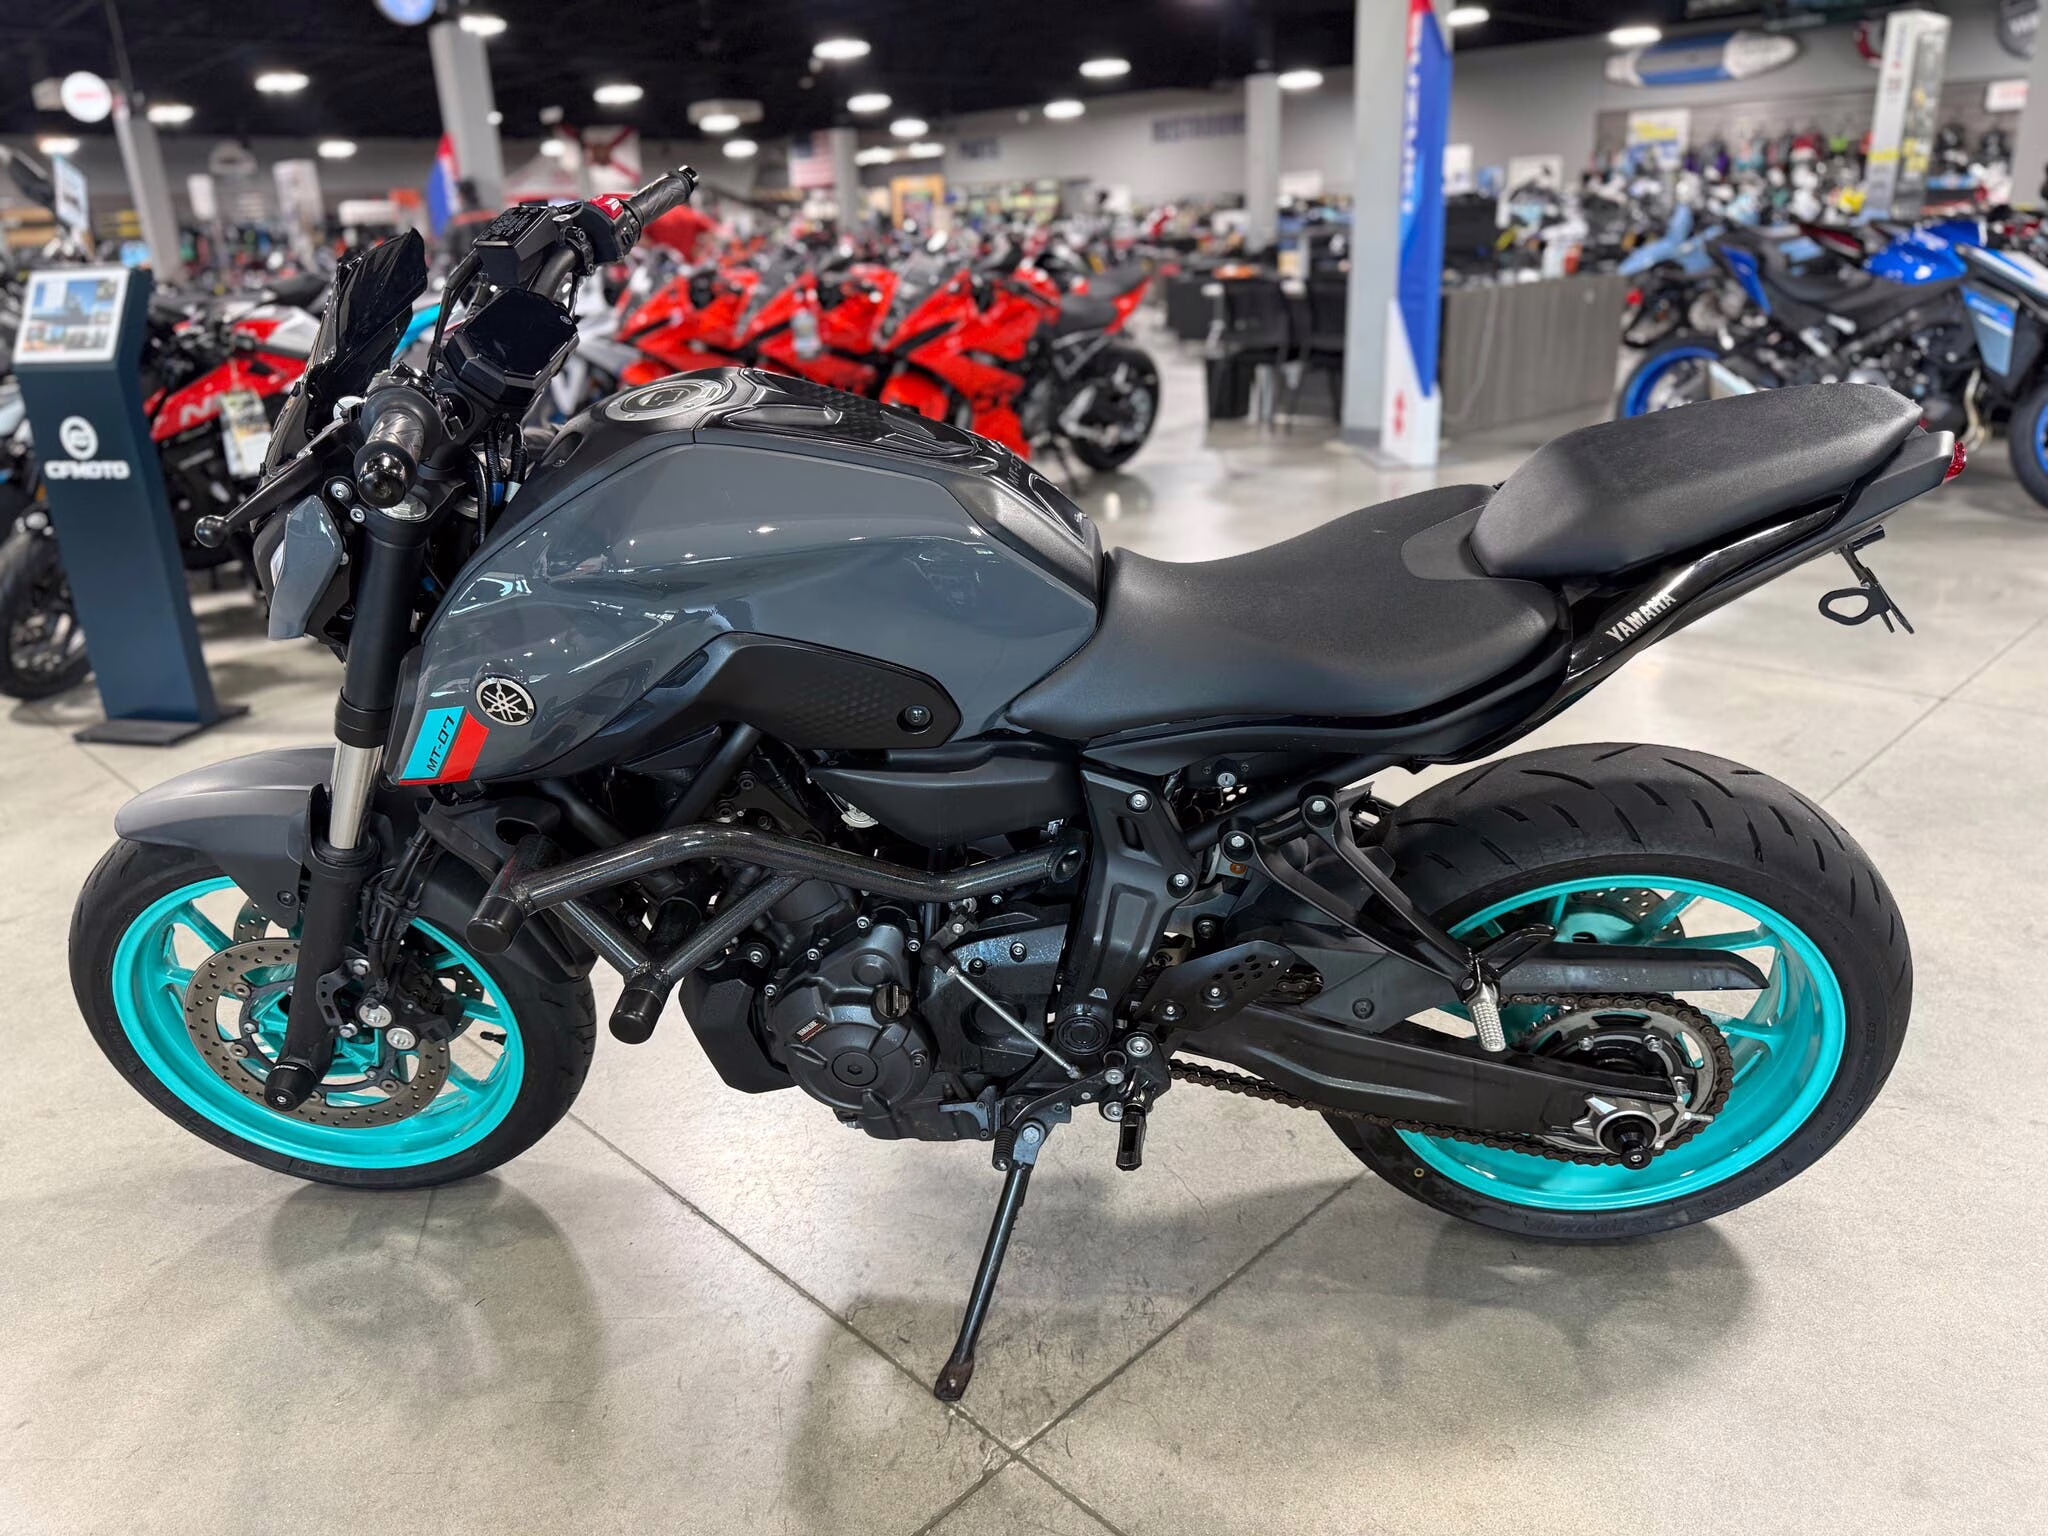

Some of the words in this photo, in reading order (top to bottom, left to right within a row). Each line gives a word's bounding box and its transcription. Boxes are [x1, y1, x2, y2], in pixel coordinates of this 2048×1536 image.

[44, 460, 130, 480] CFMOTO
[1605, 591, 1677, 642] YAMAHA
[426, 715, 455, 773] MT-07
